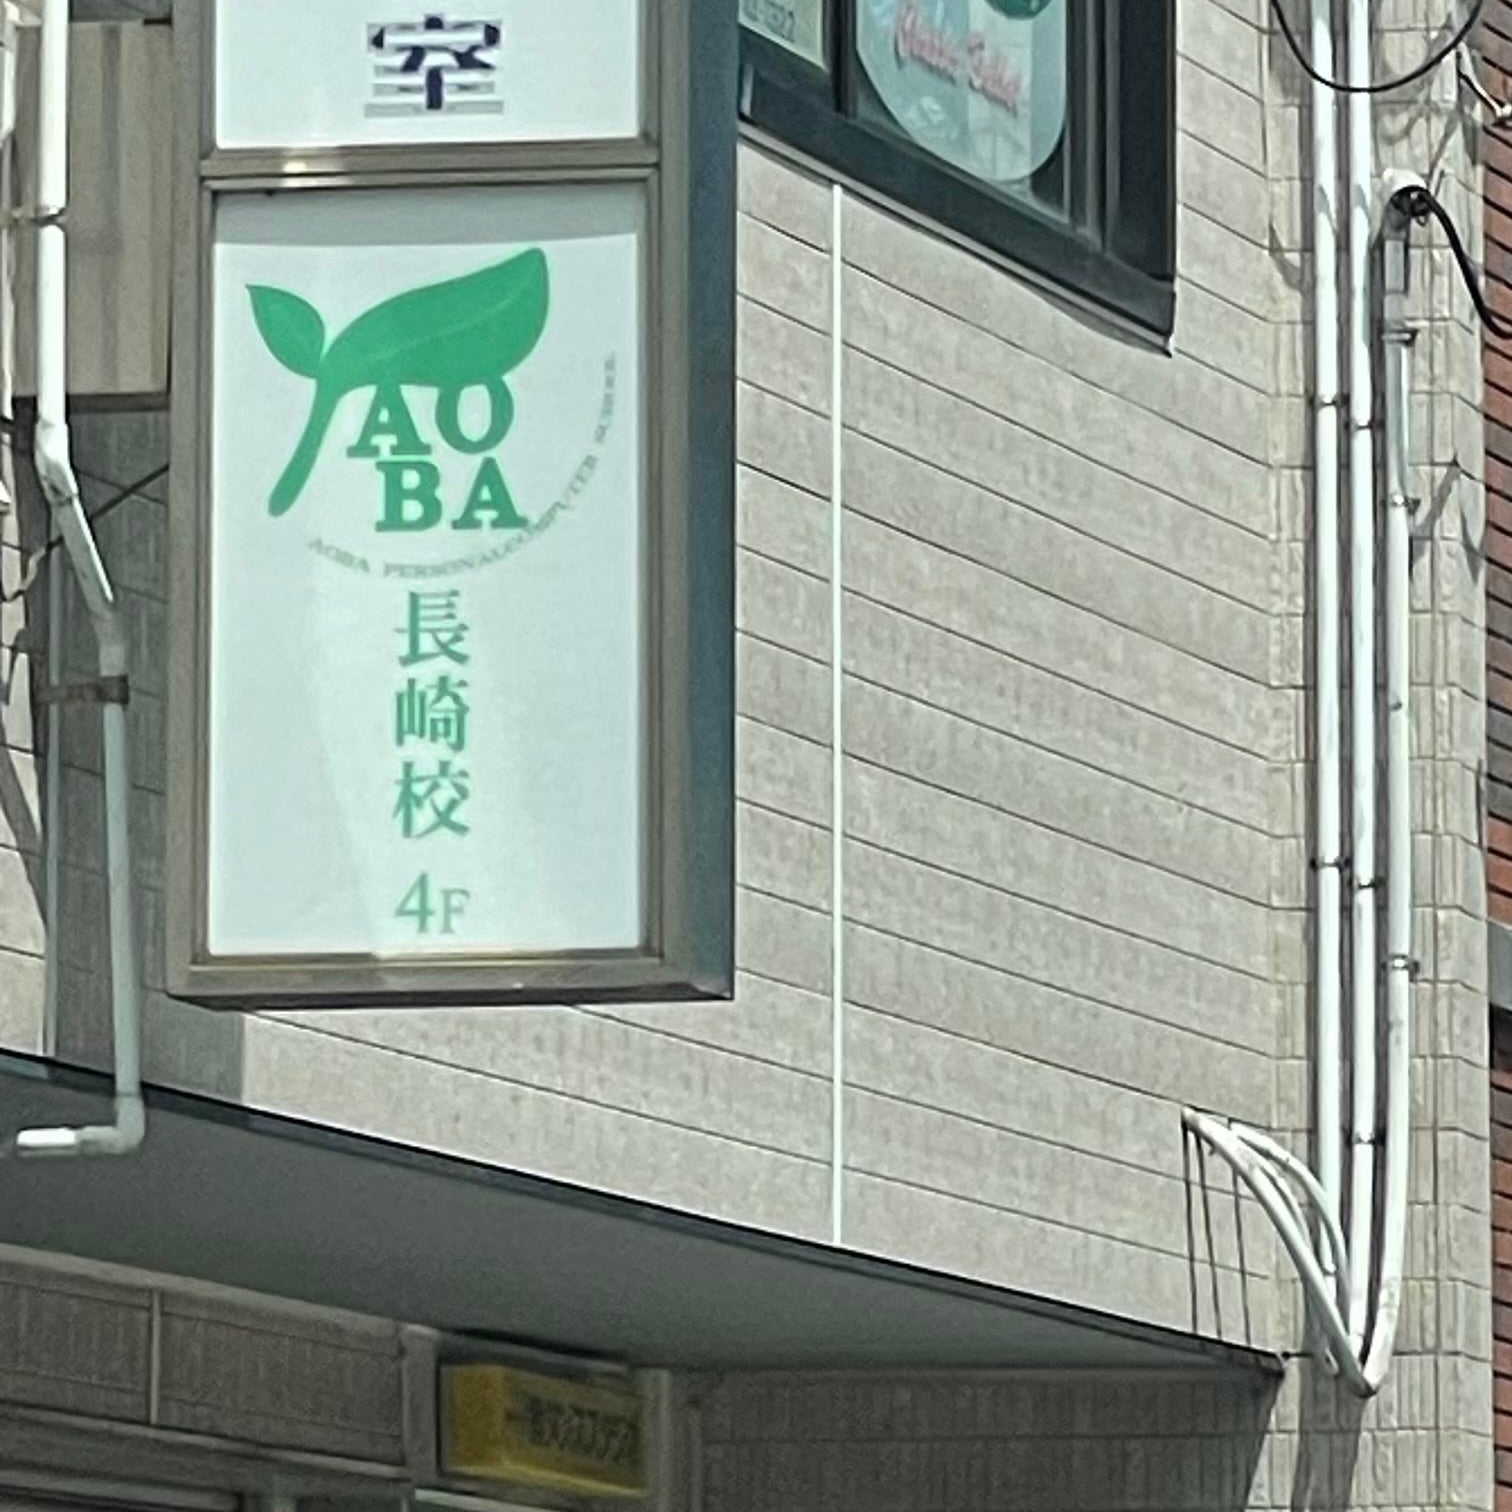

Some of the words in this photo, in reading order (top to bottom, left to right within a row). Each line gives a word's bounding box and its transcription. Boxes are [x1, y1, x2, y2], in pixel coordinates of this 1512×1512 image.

[392, 587, 471, 841] 長崎校
[394, 872, 471, 935] 4F
